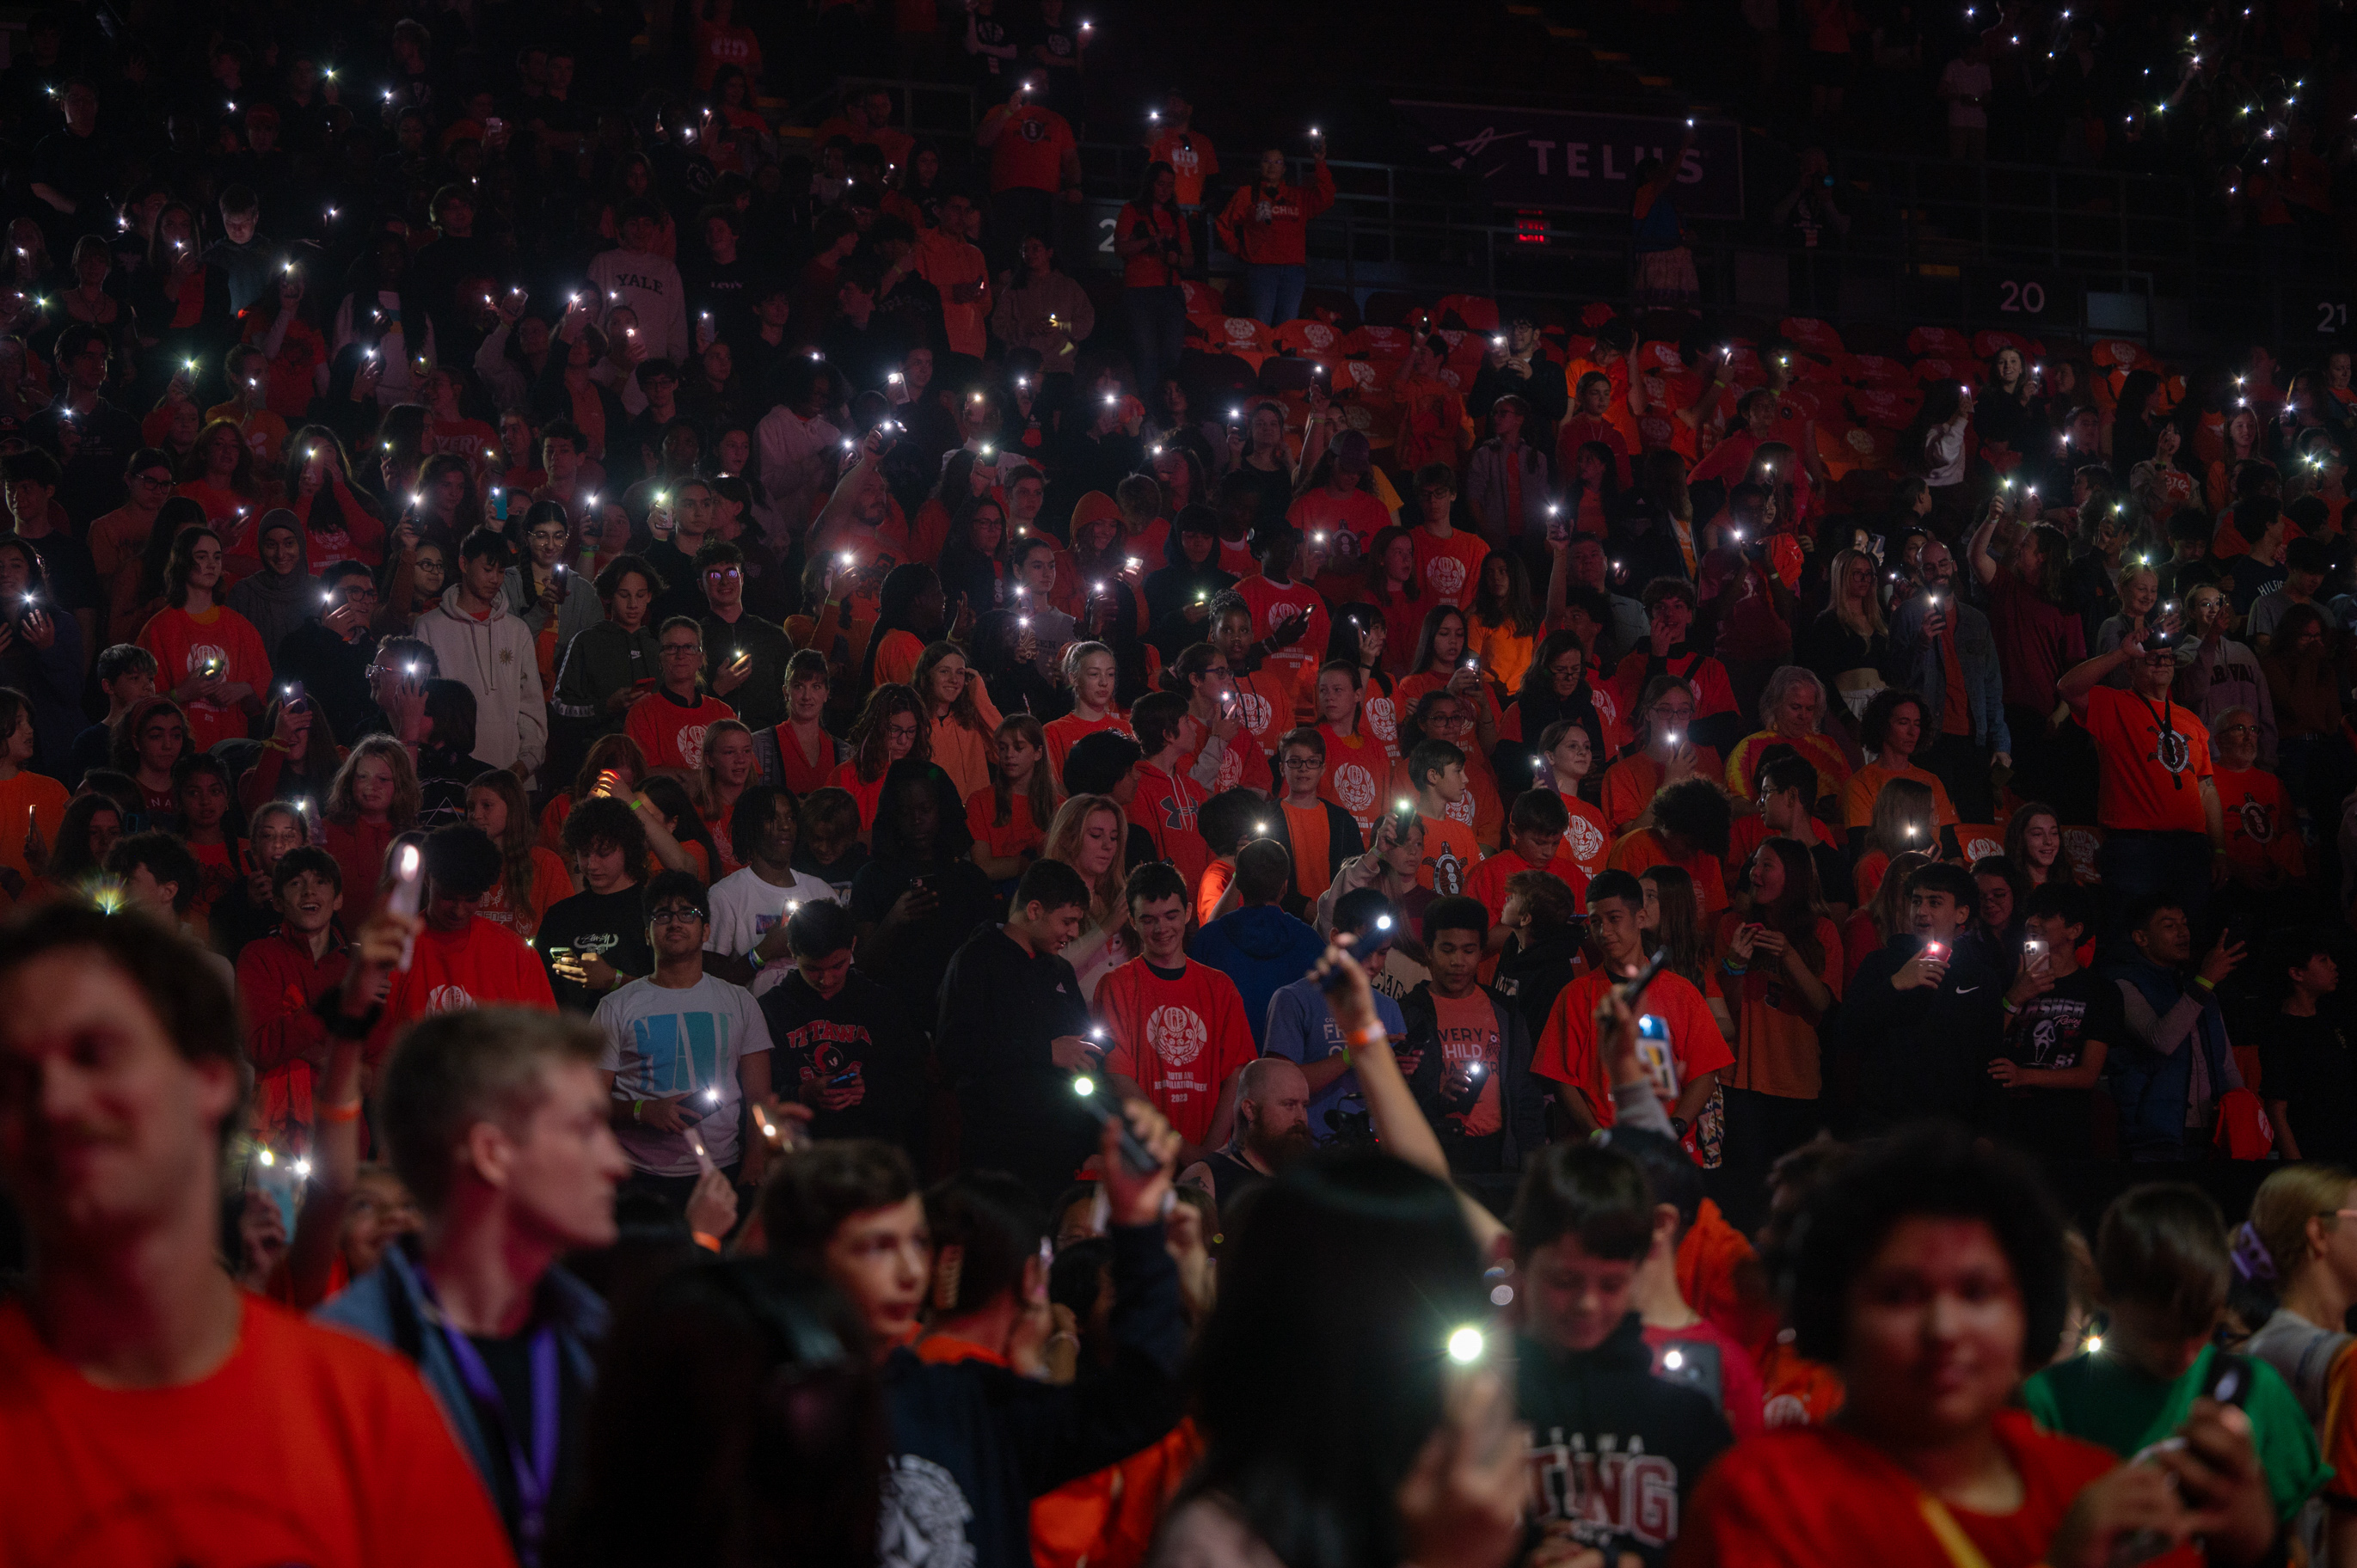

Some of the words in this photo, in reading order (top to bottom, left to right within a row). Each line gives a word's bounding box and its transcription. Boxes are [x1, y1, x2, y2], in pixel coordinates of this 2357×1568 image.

[617, 273, 664, 296] YALE
[1999, 280, 2046, 313] 20
[2317, 302, 2348, 333] 21
[1441, 1043, 1483, 1059] HILD
[1170, 1093, 1188, 1103] 2023
